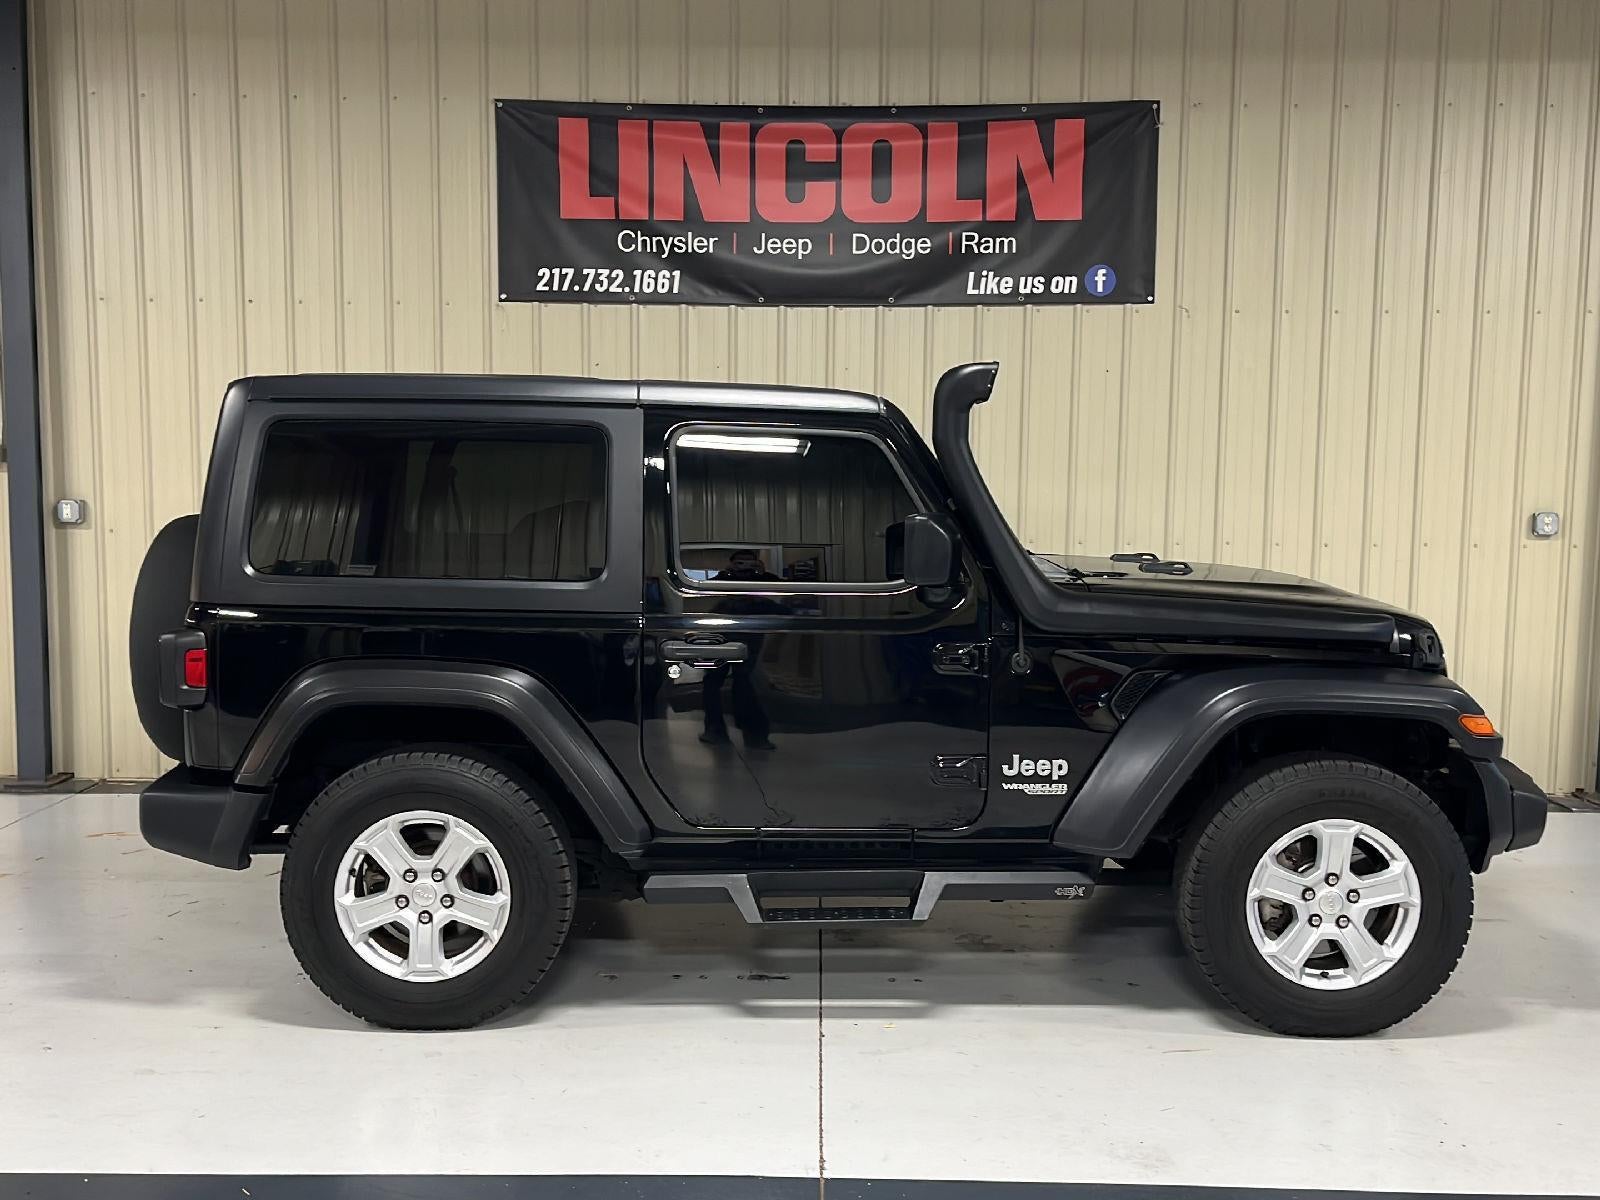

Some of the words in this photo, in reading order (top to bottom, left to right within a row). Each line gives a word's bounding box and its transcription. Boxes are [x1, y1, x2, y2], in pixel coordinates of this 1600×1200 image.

[558, 117, 1086, 223] LINCOLN
[617, 230, 719, 258] Chrysler
[753, 233, 813, 259] Jeep
[852, 233, 932, 260] Dodge
[961, 232, 1017, 254] Ram
[536, 268, 681, 294] 217.732.1661
[967, 271, 1013, 295] Like
[1018, 275, 1046, 294] us
[1050, 275, 1078, 294] on
[1002, 754, 1069, 780] Jeep
